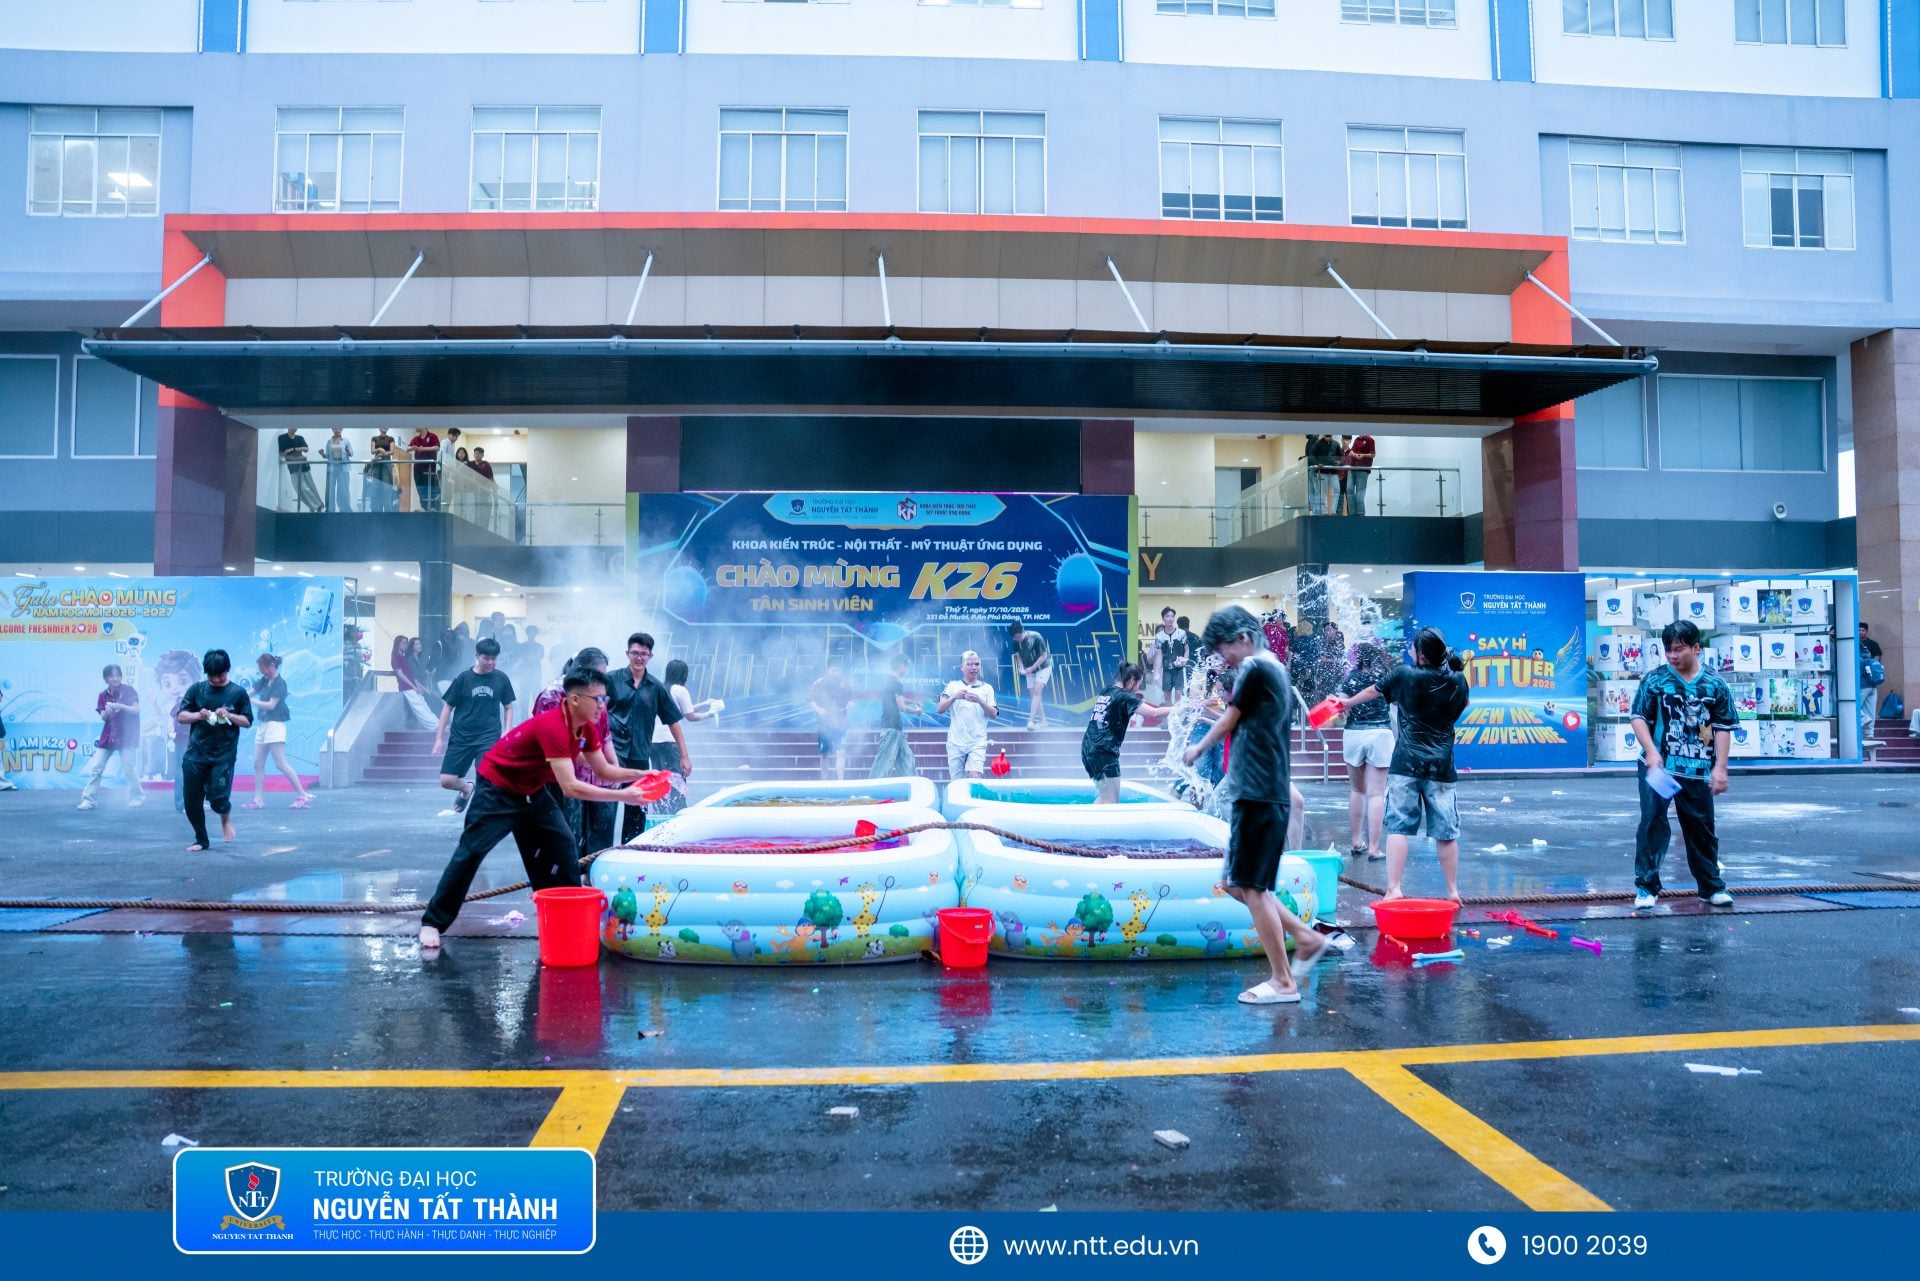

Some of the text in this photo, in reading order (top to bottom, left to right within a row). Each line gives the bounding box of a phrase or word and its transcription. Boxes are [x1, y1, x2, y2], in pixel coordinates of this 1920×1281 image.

[732, 540, 765, 550] KHOA
[769, 536, 799, 550] KIẾN
[801, 538, 835, 550] TRÚC
[844, 538, 867, 552] NỘI
[868, 537, 902, 550] THẤT
[911, 538, 933, 550] MỸ
[933, 540, 975, 552] THUẬT
[977, 538, 1005, 550] ỨNG
[1007, 541, 1043, 552] DỤNG
[716, 557, 900, 588] CHÀO MỪNG
[1141, 553, 1163, 581] Y
[908, 561, 1023, 600] K26
[59, 585, 113, 606] CHÀO
[751, 594, 874, 612] TÂN SINH VIÊN
[1483, 600, 1546, 609] NGUYỄN TẤT THÀNH
[104, 607, 135, 617] 2026
[143, 607, 174, 617] 2027
[1478, 637, 1509, 651] SAY
[1461, 707, 1543, 725] NEW ME
[10, 736, 66, 750] I AM K26
[1478, 727, 1568, 745] ADVENTURE
[2, 749, 75, 774] NTTU
